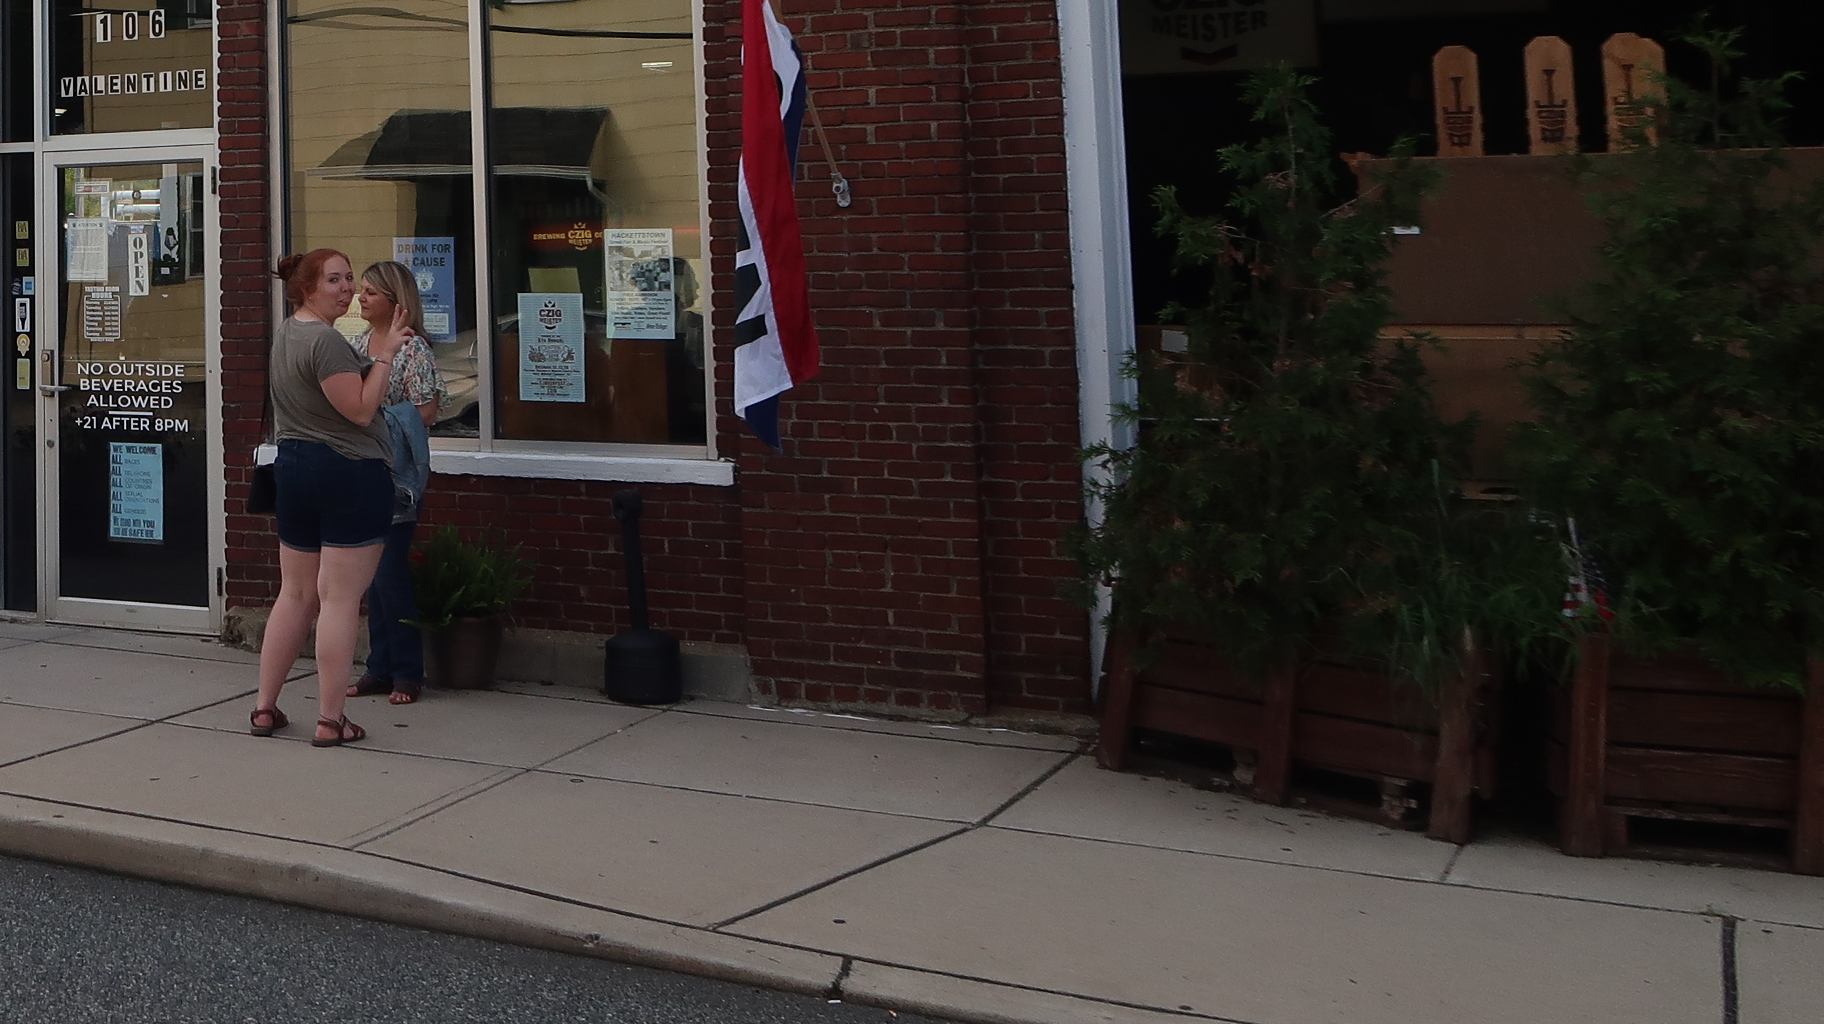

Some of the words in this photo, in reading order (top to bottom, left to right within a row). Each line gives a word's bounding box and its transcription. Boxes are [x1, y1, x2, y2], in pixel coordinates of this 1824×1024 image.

[99, 10, 163, 41] 106
[1151, 10, 1268, 42] MEISTER
[62, 70, 205, 96] VALENTINE
[568, 230, 592, 239] CZIG
[397, 244, 428, 254] DRINK
[431, 244, 451, 254] FOR
[133, 237, 144, 293] OPEN
[412, 257, 446, 267] CAUSE
[539, 309, 562, 317] CZIG
[77, 362, 104, 376] NO
[108, 363, 185, 377] OUTSIDE
[80, 378, 183, 393] BEVERAGES
[86, 394, 173, 409] ALLOWED
[75, 416, 97, 429] +21
[101, 416, 150, 431] AFTER
[154, 418, 189, 433] 8PM
[112, 445, 123, 454] WE
[126, 446, 157, 455] WELCOME
[112, 454, 123, 464] ALL
[112, 466, 122, 476] ALL
[112, 477, 123, 487] ALL
[112, 491, 123, 501] ALL
[112, 503, 122, 514] ALL
[142, 519, 155, 528] YOU
[128, 528, 144, 537] SAFE
